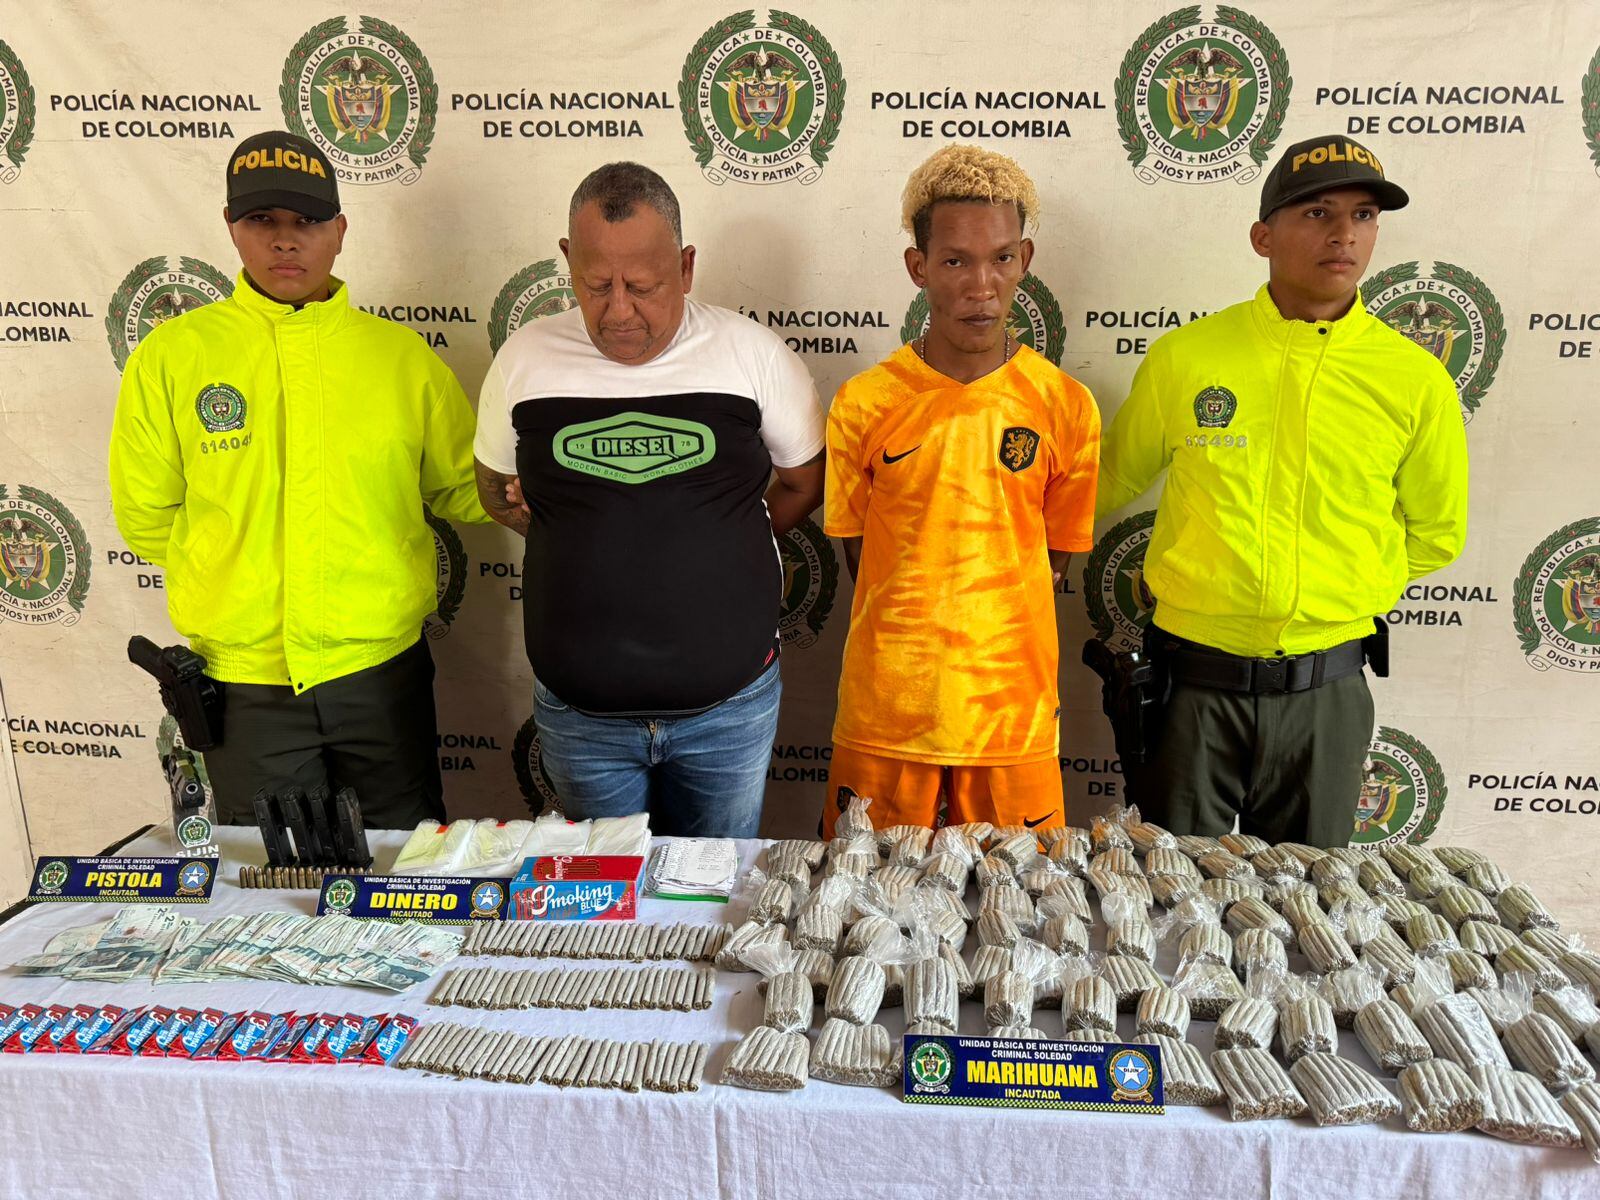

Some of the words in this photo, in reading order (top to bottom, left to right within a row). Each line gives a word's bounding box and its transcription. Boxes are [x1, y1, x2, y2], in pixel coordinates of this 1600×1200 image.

[347, 35, 365, 46] DE
[378, 42, 419, 112] COLOMBIA
[754, 30, 772, 41] DE
[785, 37, 825, 109] COLOMBIA
[1199, 26, 1219, 37] DE
[1232, 34, 1269, 106] COLOMBIA
[51, 91, 136, 113] POLICÍA
[142, 94, 261, 112] NACIONAL
[451, 88, 541, 110] POLICÍA
[550, 92, 674, 110] NACIONAL
[871, 87, 967, 110] POLICÍA
[975, 91, 1105, 109] NACIONAL
[1316, 82, 1416, 106] POLICÍA
[1425, 86, 1564, 105] NACIONAL
[82, 122, 111, 138] DE
[116, 121, 234, 139] COLOMBIA
[483, 121, 512, 138] DE
[519, 120, 643, 138] COLOMBIA
[902, 120, 933, 138] DE
[941, 120, 1071, 138] COLOMBIA
[1346, 116, 1382, 134] DE
[1388, 116, 1525, 134] COLOMBIA
[364, 125, 416, 167] NACIONAL
[762, 123, 820, 165] NACIONAL
[1198, 119, 1261, 164] NACIONAL
[233, 148, 326, 179] POLICIA
[364, 162, 405, 182] PATRIA
[720, 161, 750, 181] DIOS
[762, 160, 805, 181] PATRIA
[1153, 160, 1183, 179] DIOS
[1197, 160, 1243, 181] PATRIA
[168, 274, 186, 283] DE
[0, 302, 93, 317] ACIONAL
[1086, 307, 1181, 328] POLICÍA
[1416, 281, 1435, 290] DE
[1449, 288, 1483, 356] COLOMBIA
[768, 311, 889, 327] NACIONAL
[1116, 338, 1147, 354] DE
[1559, 341, 1592, 358] DE
[596, 437, 680, 459] DIESEL
[567, 460, 601, 473] MODERN
[604, 469, 628, 480] BASIC
[643, 468, 665, 480] WORK
[668, 456, 705, 472] CLOTHES
[9, 501, 23, 509] DE
[35, 507, 75, 565] COLOMBIA
[137, 575, 163, 588] DE
[30, 576, 73, 609] NACIONAL
[31, 607, 65, 623] PATRIA
[1546, 649, 1576, 669] DIOS
[45, 720, 146, 738] NACIONAL
[23, 740, 122, 758] COLOMBIA
[1392, 749, 1426, 809] COLOMBIA
[1468, 772, 1557, 790] POLICÍA
[1087, 781, 1116, 796] DE
[1494, 797, 1522, 812] DE
[85, 872, 163, 888] PISTOLA
[389, 877, 411, 885] BÁSICA
[422, 877, 471, 886] INVESTIGACIÓN
[417, 884, 447, 892] SOLEDAD
[99, 889, 140, 897] INCAUTADA
[369, 892, 458, 911] DINERO
[531, 884, 617, 916] Smoking
[580, 897, 602, 911] BLUE
[390, 910, 433, 918] INCAUTADO
[959, 1039, 991, 1049] UNIDAD
[992, 1039, 1024, 1050] BÁSICA
[1024, 1042, 1037, 1051] DE
[1038, 1041, 1104, 1053] INVESTIGACIÓN
[991, 1050, 1032, 1059] CRIMINAL
[1034, 1051, 1073, 1061] SOLEDAD
[966, 1060, 1098, 1089] MARIHUANA
[1004, 1088, 1061, 1100] INCAUTADA
